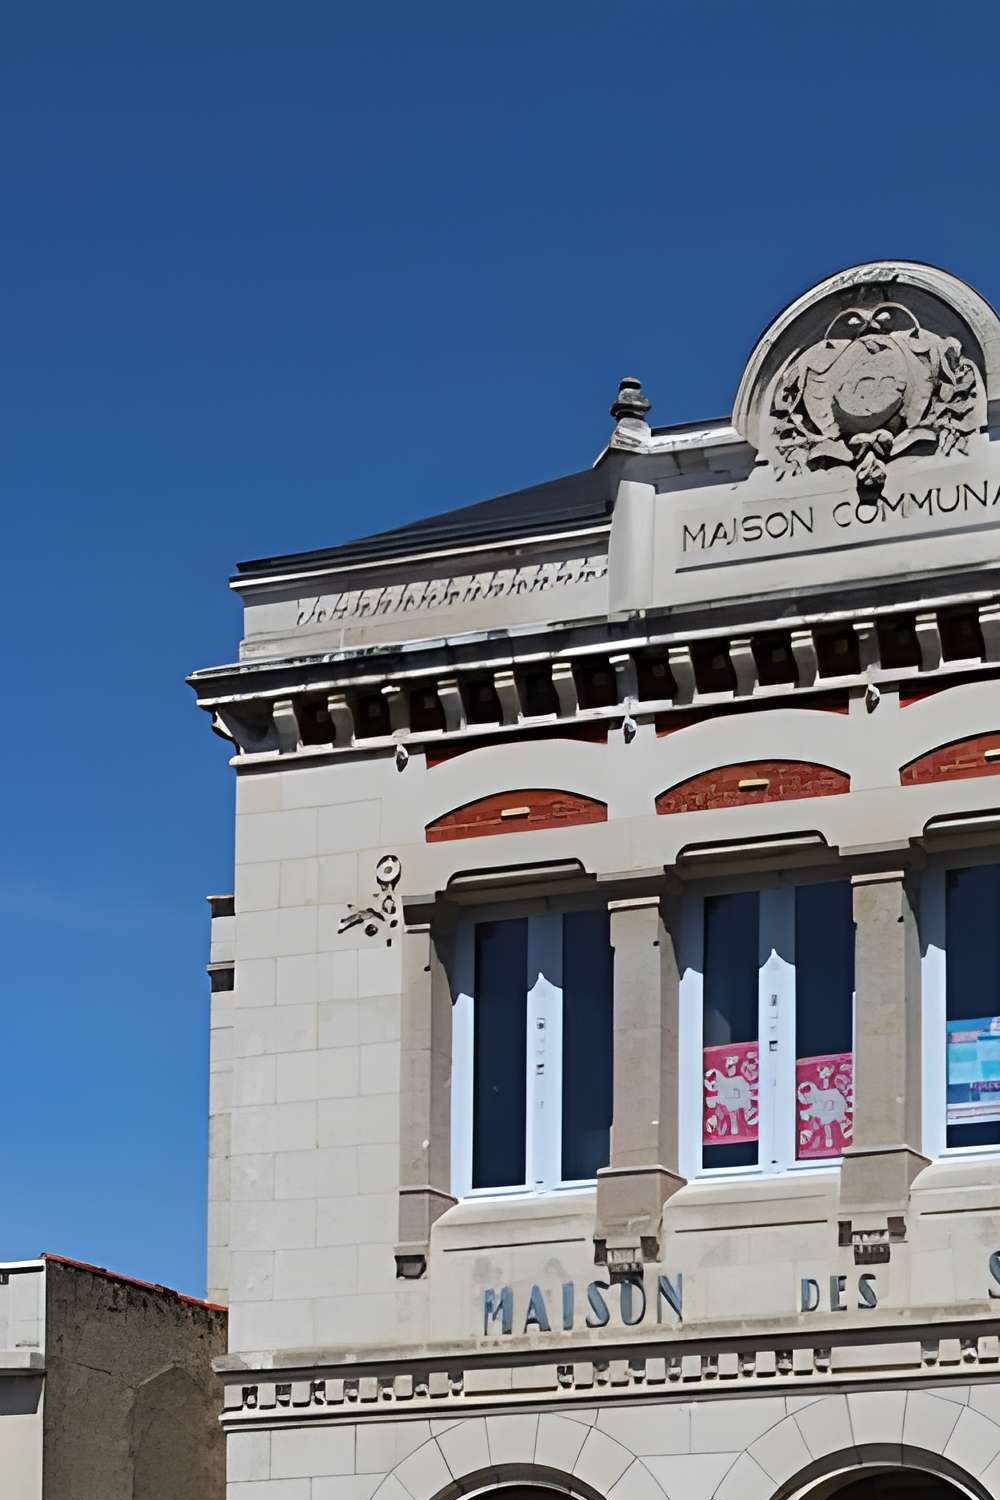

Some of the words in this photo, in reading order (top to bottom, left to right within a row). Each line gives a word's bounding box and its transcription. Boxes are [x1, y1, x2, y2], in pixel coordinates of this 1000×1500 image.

[681, 505, 814, 552] MAISON
[483, 1272, 684, 1336] MAISON
[800, 1272, 879, 1313] DES
